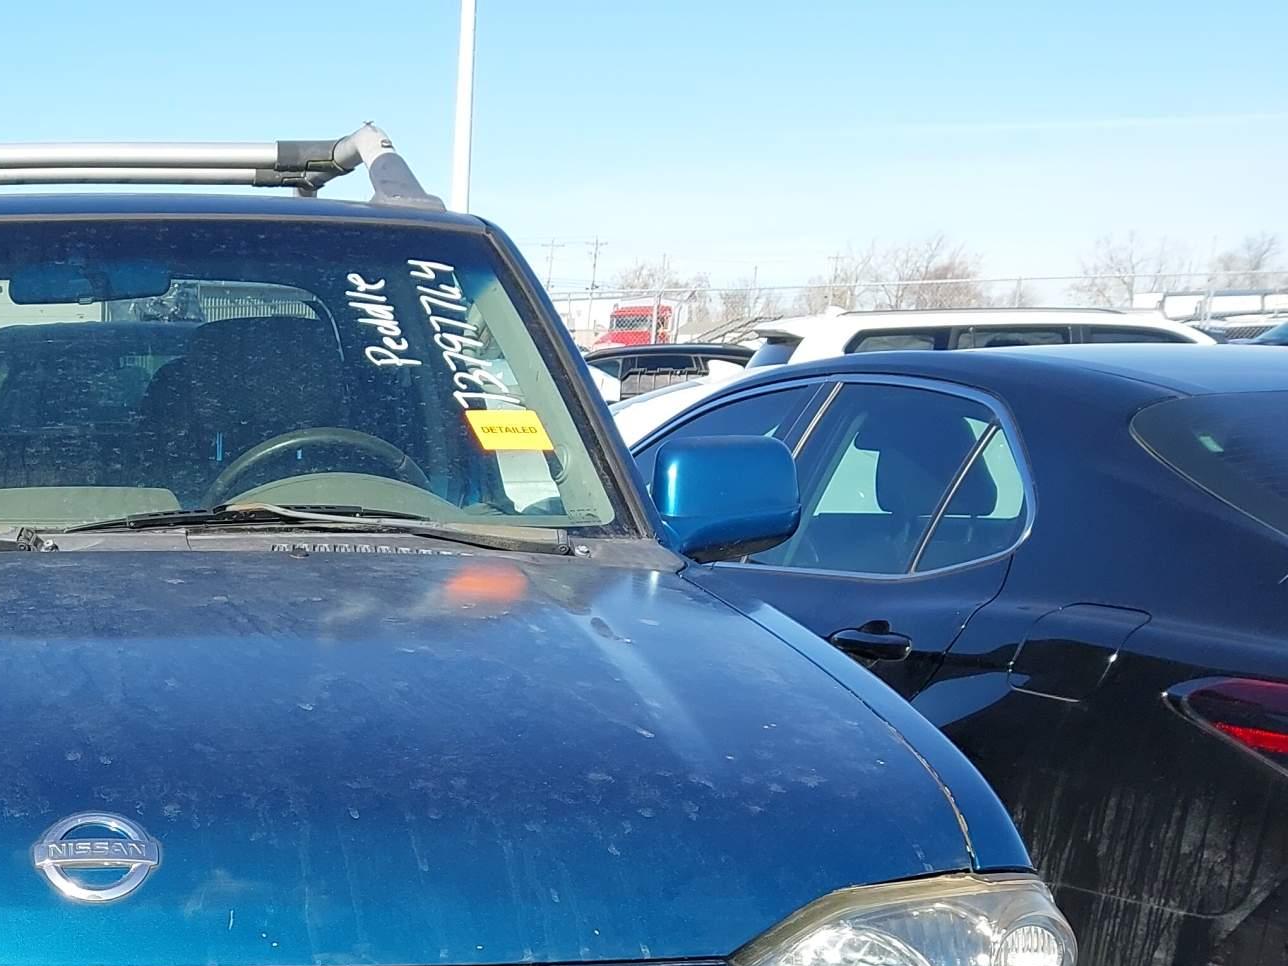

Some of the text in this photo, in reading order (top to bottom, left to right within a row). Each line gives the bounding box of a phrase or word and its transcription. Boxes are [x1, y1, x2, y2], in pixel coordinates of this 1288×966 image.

[345, 272, 421, 367] Peddle
[407, 258, 521, 409] 73797764
[480, 425, 538, 434] DETAILED
[47, 841, 146, 858] NISSAN
